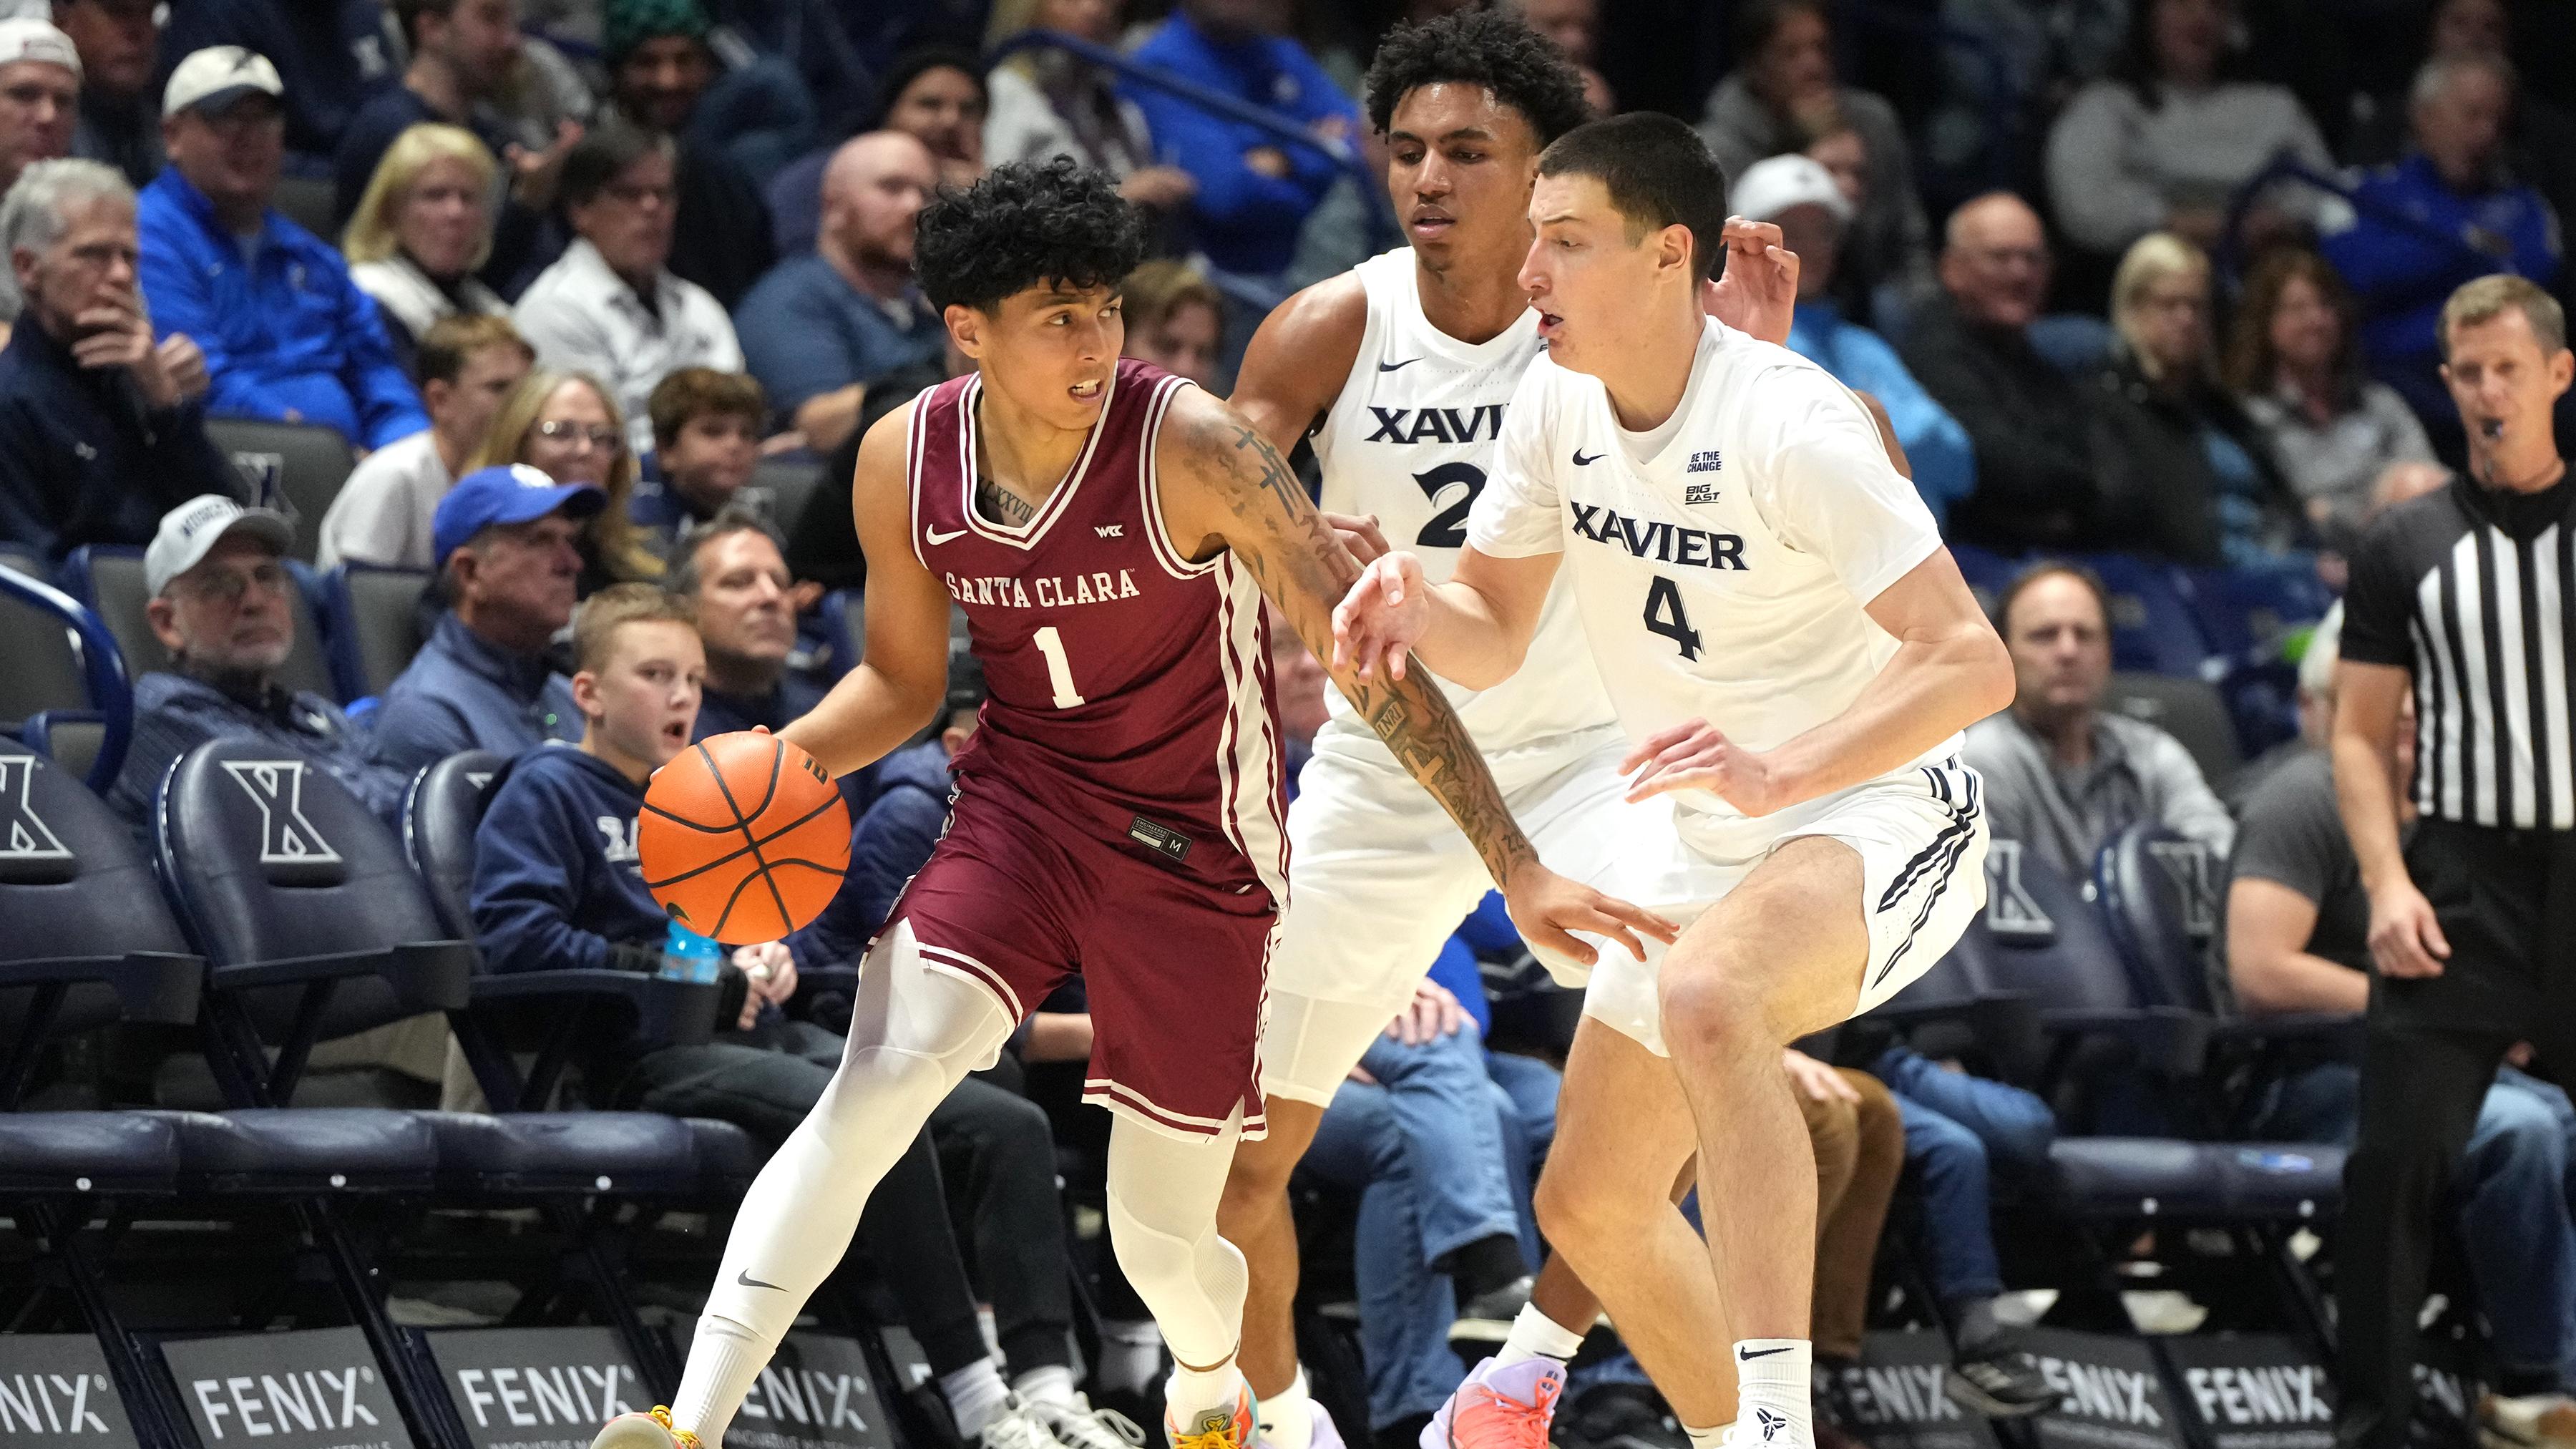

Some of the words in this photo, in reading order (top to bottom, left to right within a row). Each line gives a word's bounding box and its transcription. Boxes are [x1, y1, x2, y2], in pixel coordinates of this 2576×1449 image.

[1364, 403, 1510, 444] XAVI
[1687, 461, 1722, 473] CHANGE
[1691, 452, 1700, 463] BE
[1702, 451, 1720, 462] THE
[1411, 462, 1489, 548] 2
[1685, 492, 1720, 502] EAST
[1686, 483, 1711, 494] BIG
[1570, 499, 1750, 571] XAVIER
[946, 572, 1031, 608] SANTA
[1035, 569, 1140, 608] CLARA
[1643, 575, 1706, 663] 4
[1033, 626, 1086, 710] 1
[1136, 819, 1167, 836] ENGINEERED
[1169, 839, 1182, 852] M
[0, 1374, 109, 1433] NIX
[192, 1367, 379, 1440] FENIX
[457, 1365, 634, 1428] FENIX
[2185, 1365, 2334, 1425] FENIX
